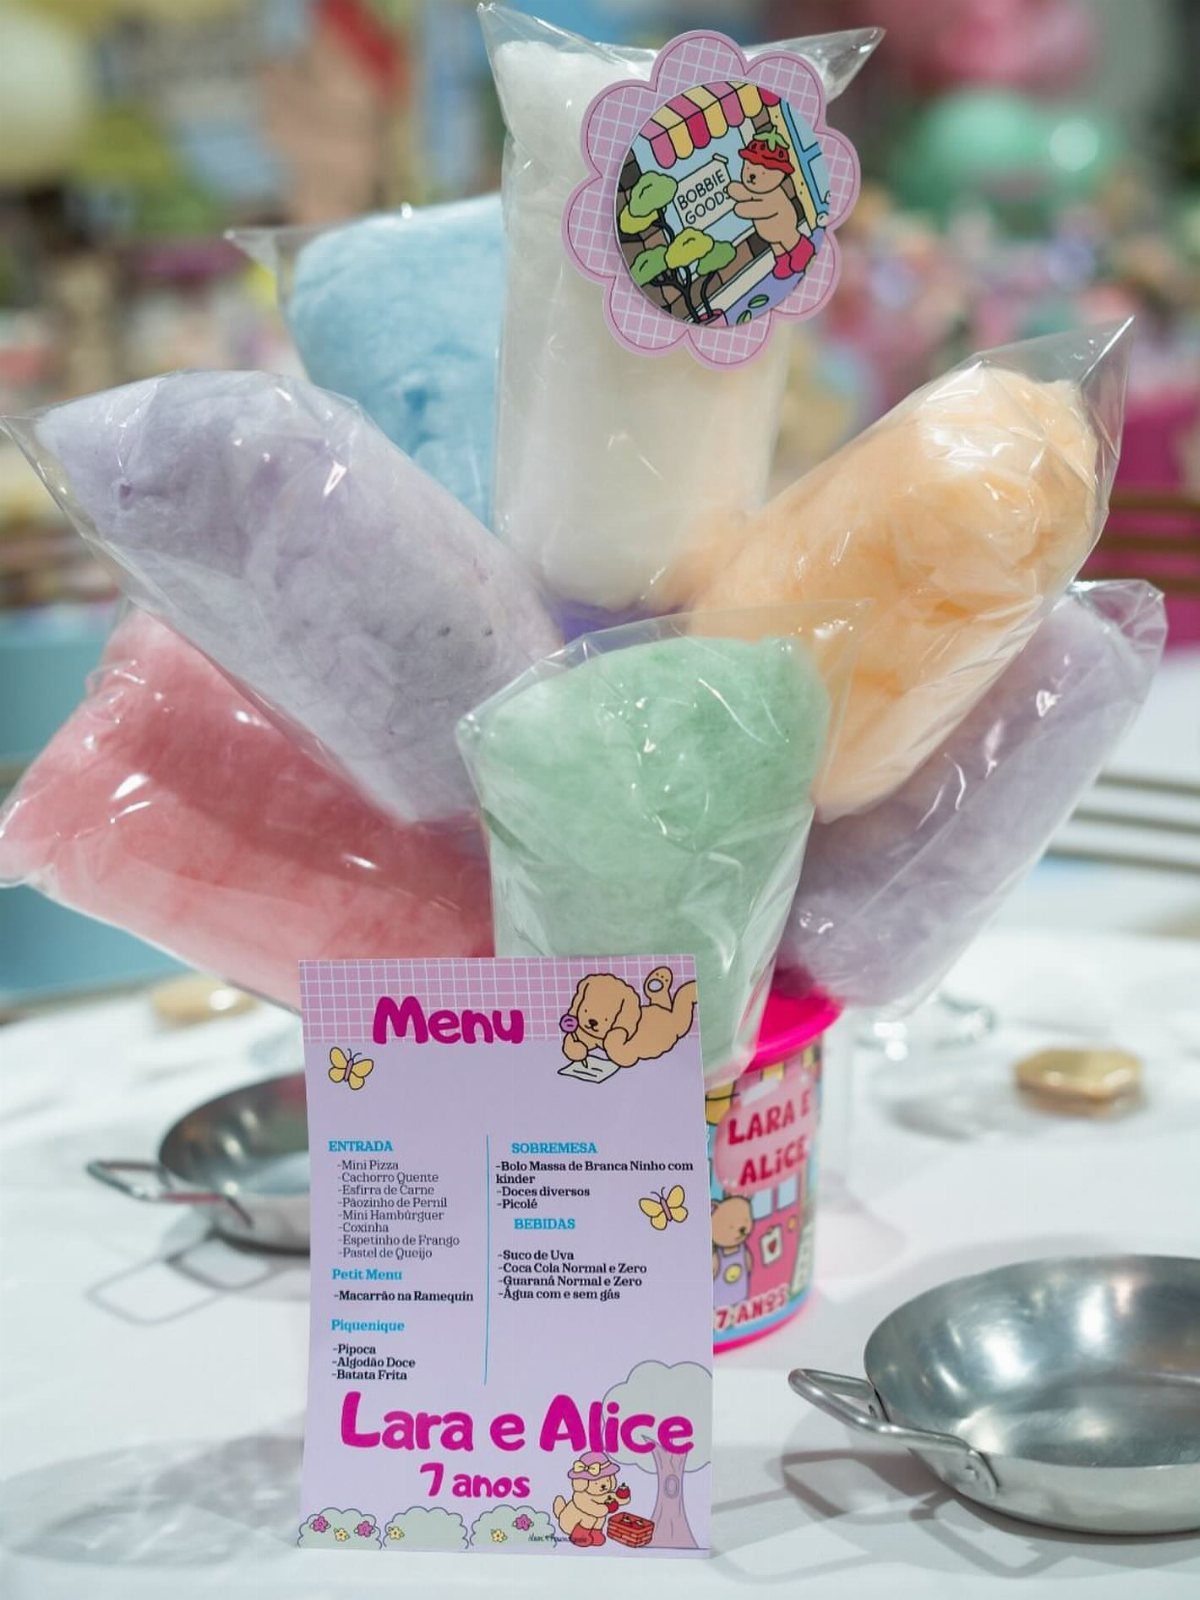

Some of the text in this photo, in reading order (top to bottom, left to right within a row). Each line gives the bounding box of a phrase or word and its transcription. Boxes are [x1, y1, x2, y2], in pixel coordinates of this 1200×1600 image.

[677, 169, 726, 210] BOBBIE
[372, 996, 525, 1044] Menu
[728, 1100, 795, 1145] LARA
[328, 1140, 393, 1152] ENTRADA
[511, 1142, 598, 1154] SOBREMESA
[369, 1159, 399, 1171] Pizza
[495, 1160, 694, 1171] -Bolo Massa de Branca Ninho com
[396, 1172, 439, 1185] Quente
[495, 1173, 535, 1184] kinder
[384, 1184, 397, 1195] de
[400, 1184, 435, 1195] Carne
[496, 1186, 590, 1197] -Doces diversos
[396, 1197, 410, 1208] de
[413, 1197, 448, 1208] Pernil
[497, 1198, 538, 1209] -Picolé
[370, 1209, 445, 1223] Hambúrguer
[514, 1218, 576, 1230] BEBIDAS
[402, 1234, 416, 1246] de
[418, 1234, 460, 1248] Frango
[379, 1247, 394, 1258] de
[395, 1247, 433, 1260] Queijo
[498, 1250, 574, 1260] -Suco de Uva
[332, 1268, 403, 1280] Petit Menu
[498, 1263, 647, 1273] -Coca Cola Normal e Zero
[557, 1276, 602, 1286] Normal
[603, 1278, 612, 1286] e
[613, 1276, 642, 1286] Zero
[334, 1290, 474, 1303] -Macarrão na Ramequin
[536, 1290, 561, 1299] com
[563, 1291, 571, 1299] e
[572, 1290, 598, 1299] sem
[599, 1288, 620, 1301] gás
[716, 1310, 728, 1328] 7
[331, 1319, 405, 1333] Piquenique
[333, 1343, 376, 1356] -Pipoca
[332, 1357, 416, 1369] -Algodão Doce
[332, 1369, 407, 1380] -Batata Frita
[341, 1391, 694, 1454] Lara e Alice
[420, 1462, 531, 1498] 7 anos
